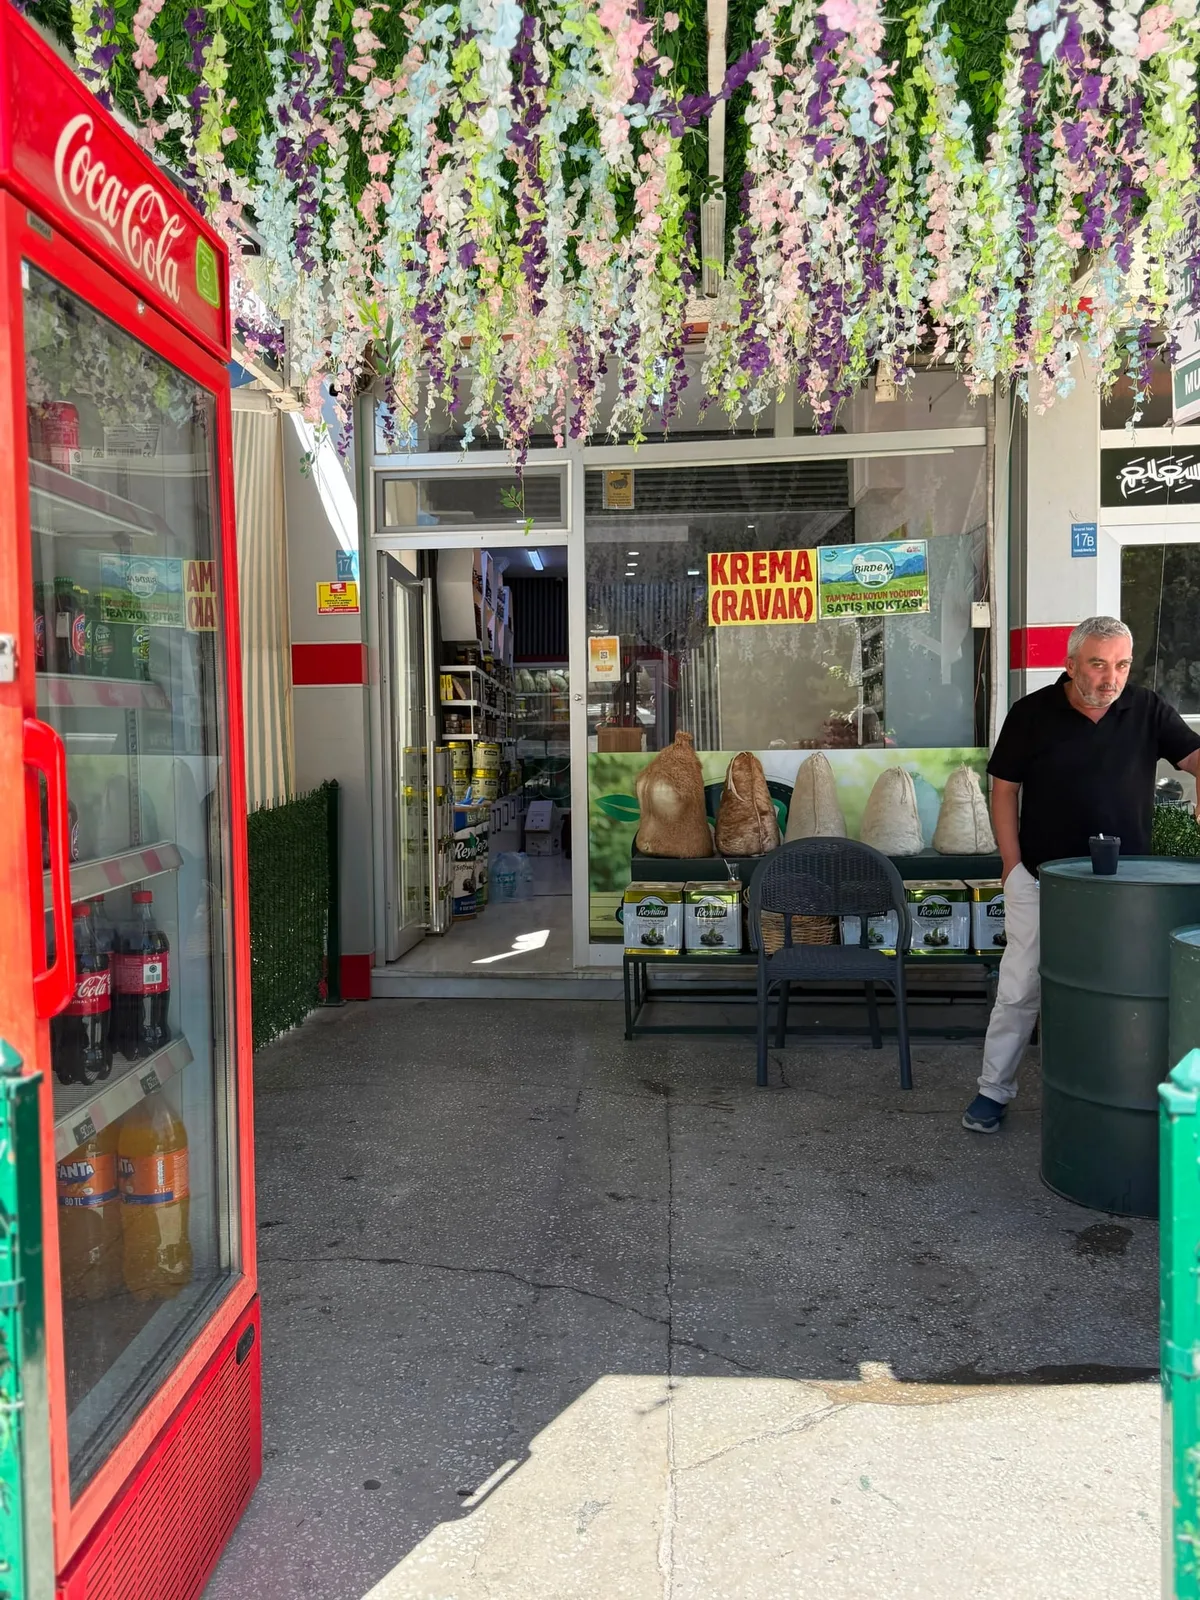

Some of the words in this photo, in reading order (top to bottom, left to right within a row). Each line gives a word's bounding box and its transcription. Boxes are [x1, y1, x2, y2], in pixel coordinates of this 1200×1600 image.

[54, 114, 187, 303] Coca-Cola
[1074, 533, 1095, 547] 17B
[711, 550, 813, 586] KREMA
[826, 594, 843, 603] TAM
[863, 590, 888, 601] KOYUN
[889, 588, 924, 600] YOĞURDU
[711, 586, 814, 625] (RAVAK)
[827, 602, 863, 614] SATIŞ
[866, 598, 923, 611] NOKTASI
[64, 1196, 73, 1206] 80
